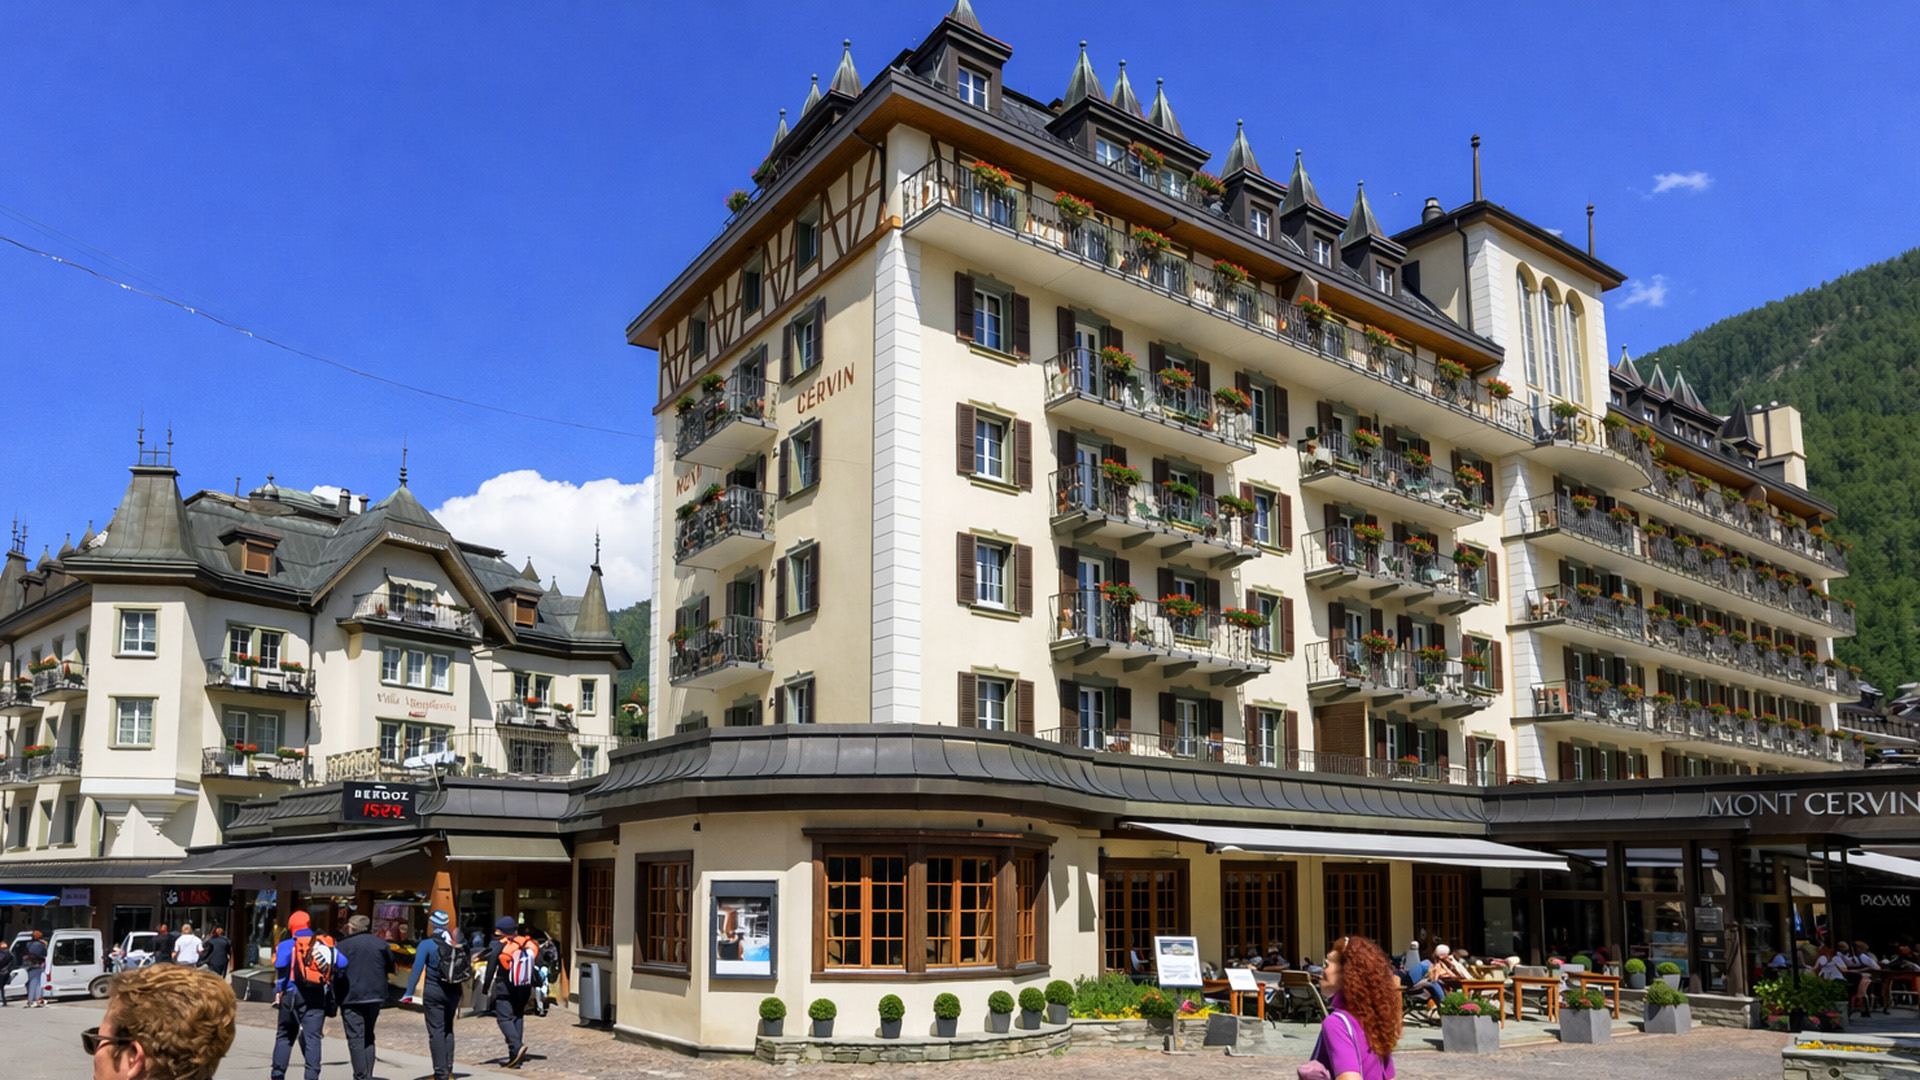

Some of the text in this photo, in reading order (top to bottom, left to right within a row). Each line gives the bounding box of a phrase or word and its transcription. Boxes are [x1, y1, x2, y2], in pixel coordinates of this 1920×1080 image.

[797, 361, 855, 415] CERVIN
[1710, 790, 1920, 817] MONT CERVIN
